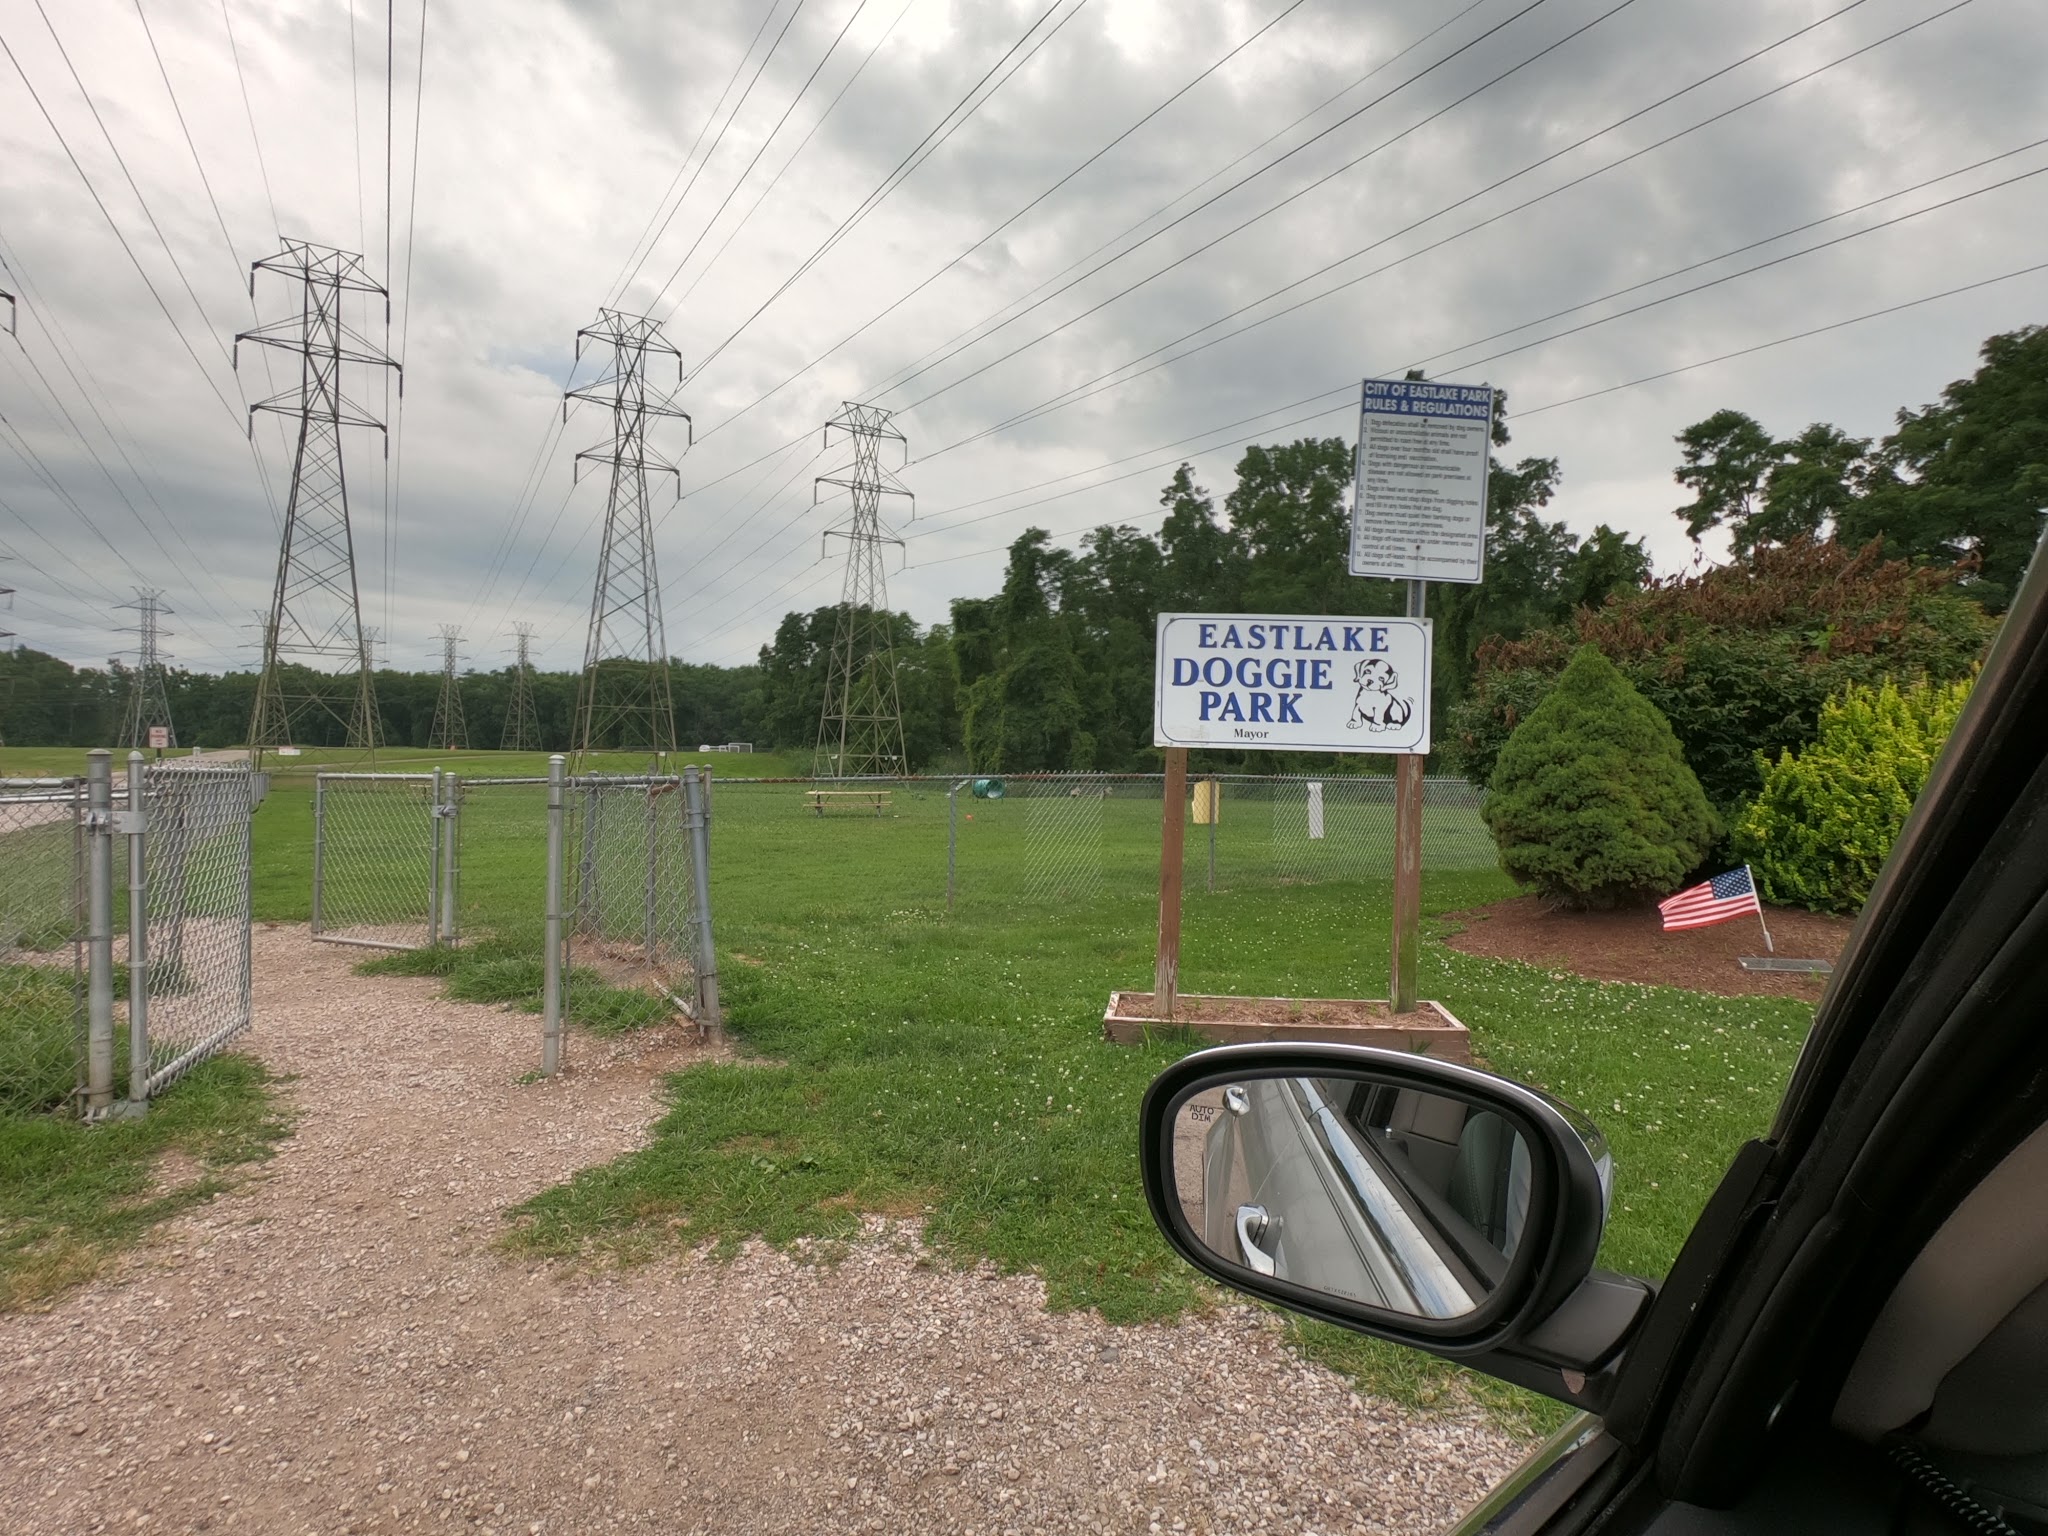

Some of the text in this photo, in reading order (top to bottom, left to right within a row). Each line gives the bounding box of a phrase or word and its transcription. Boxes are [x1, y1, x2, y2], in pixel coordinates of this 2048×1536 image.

[1365, 383, 1490, 402] CITY OF EASTLAKE PARK
[1365, 398, 1488, 418] RULES & REGULATIONS
[1198, 624, 1389, 652] EASTLAKE
[1171, 657, 1333, 690] DOGGIE
[1198, 691, 1304, 723] PARK
[1234, 728, 1269, 740] Mayor
[1190, 1105, 1214, 1115] AUTO
[1192, 1112, 1211, 1122] DIM
